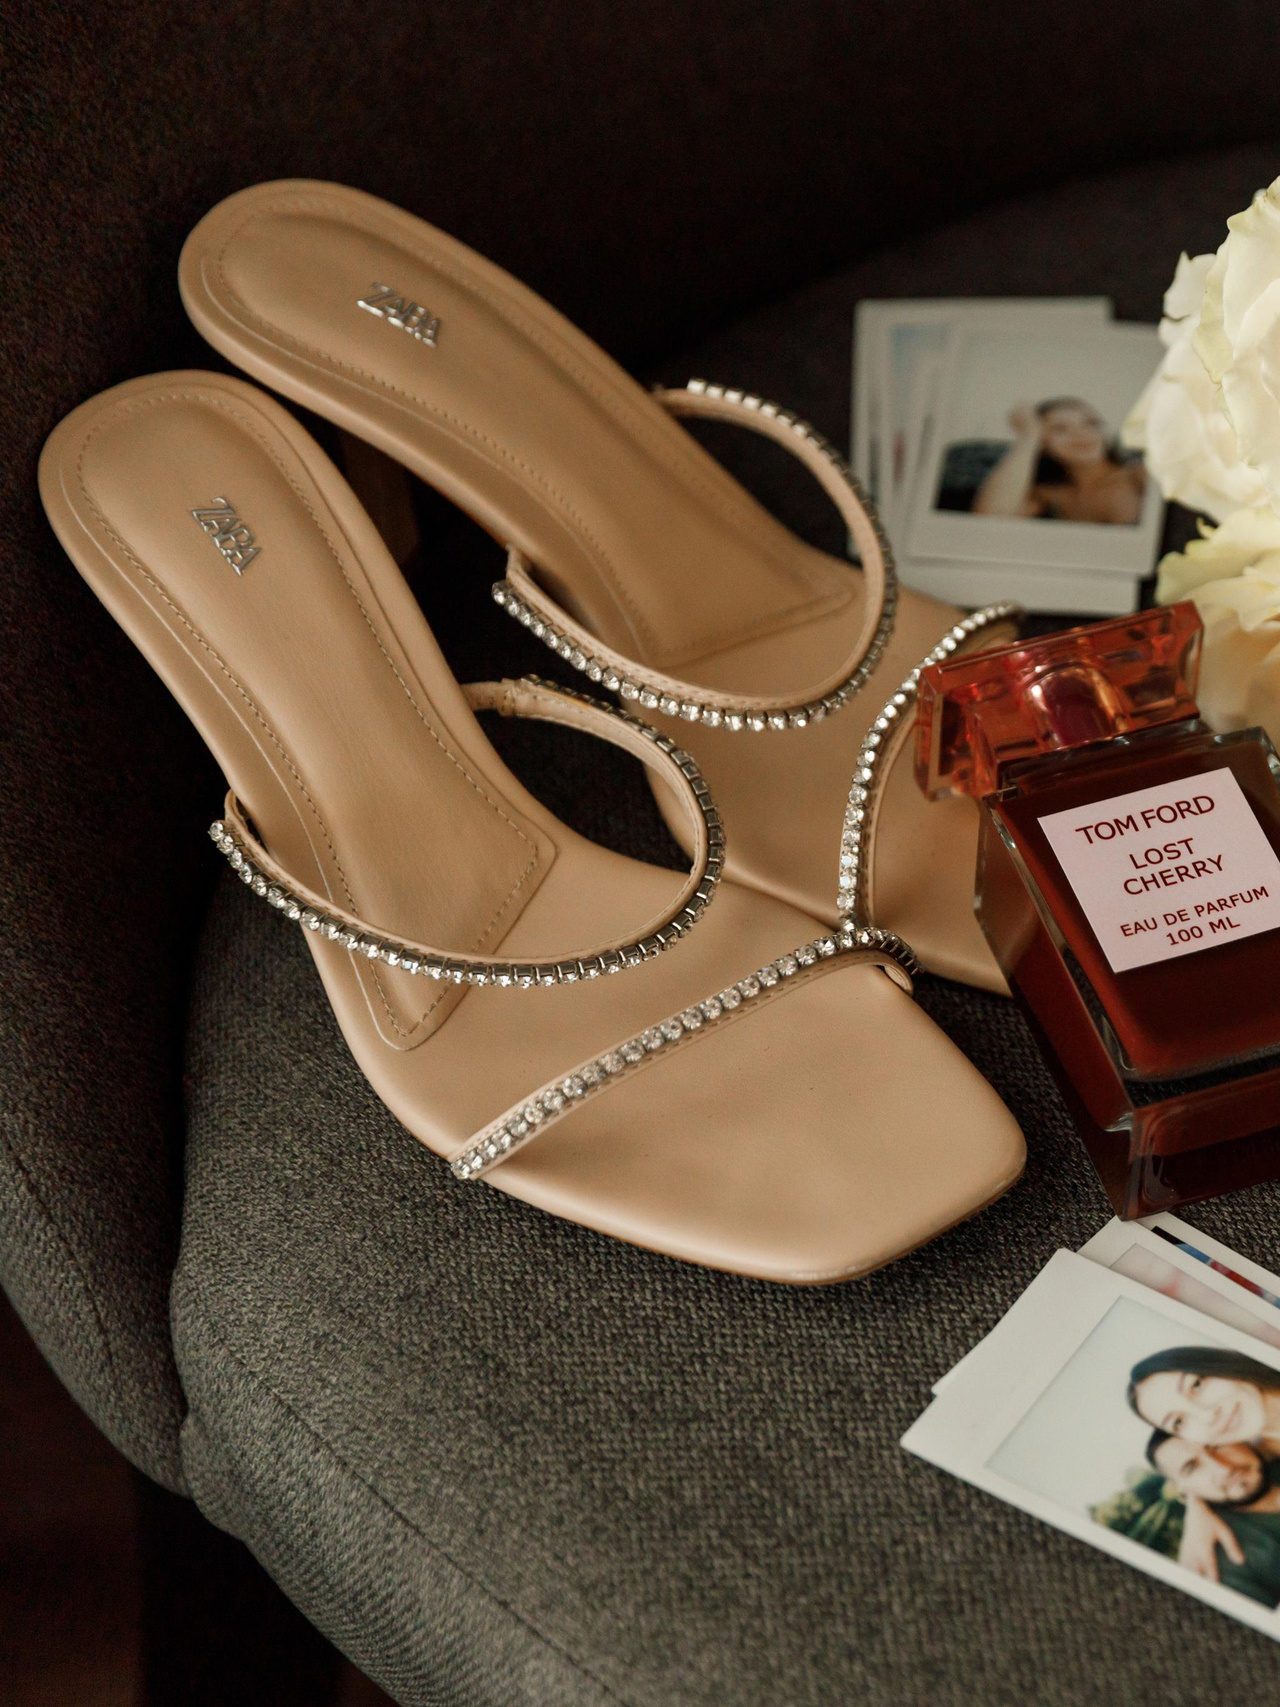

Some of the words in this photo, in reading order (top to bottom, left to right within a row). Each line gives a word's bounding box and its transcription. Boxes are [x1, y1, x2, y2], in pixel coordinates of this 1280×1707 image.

[356, 282, 440, 348] ZARA
[190, 496, 262, 576] ZARA
[1075, 815, 1139, 844] TOM
[1141, 795, 1215, 828] FORD
[1123, 854, 1224, 895] CHERRY
[1129, 837, 1195, 869] LOST
[1120, 917, 1158, 937] EAU
[1163, 909, 1191, 926] DE
[1194, 885, 1270, 917] PARFUM
[1166, 925, 1203, 945] 100
[1208, 916, 1241, 934] ML
